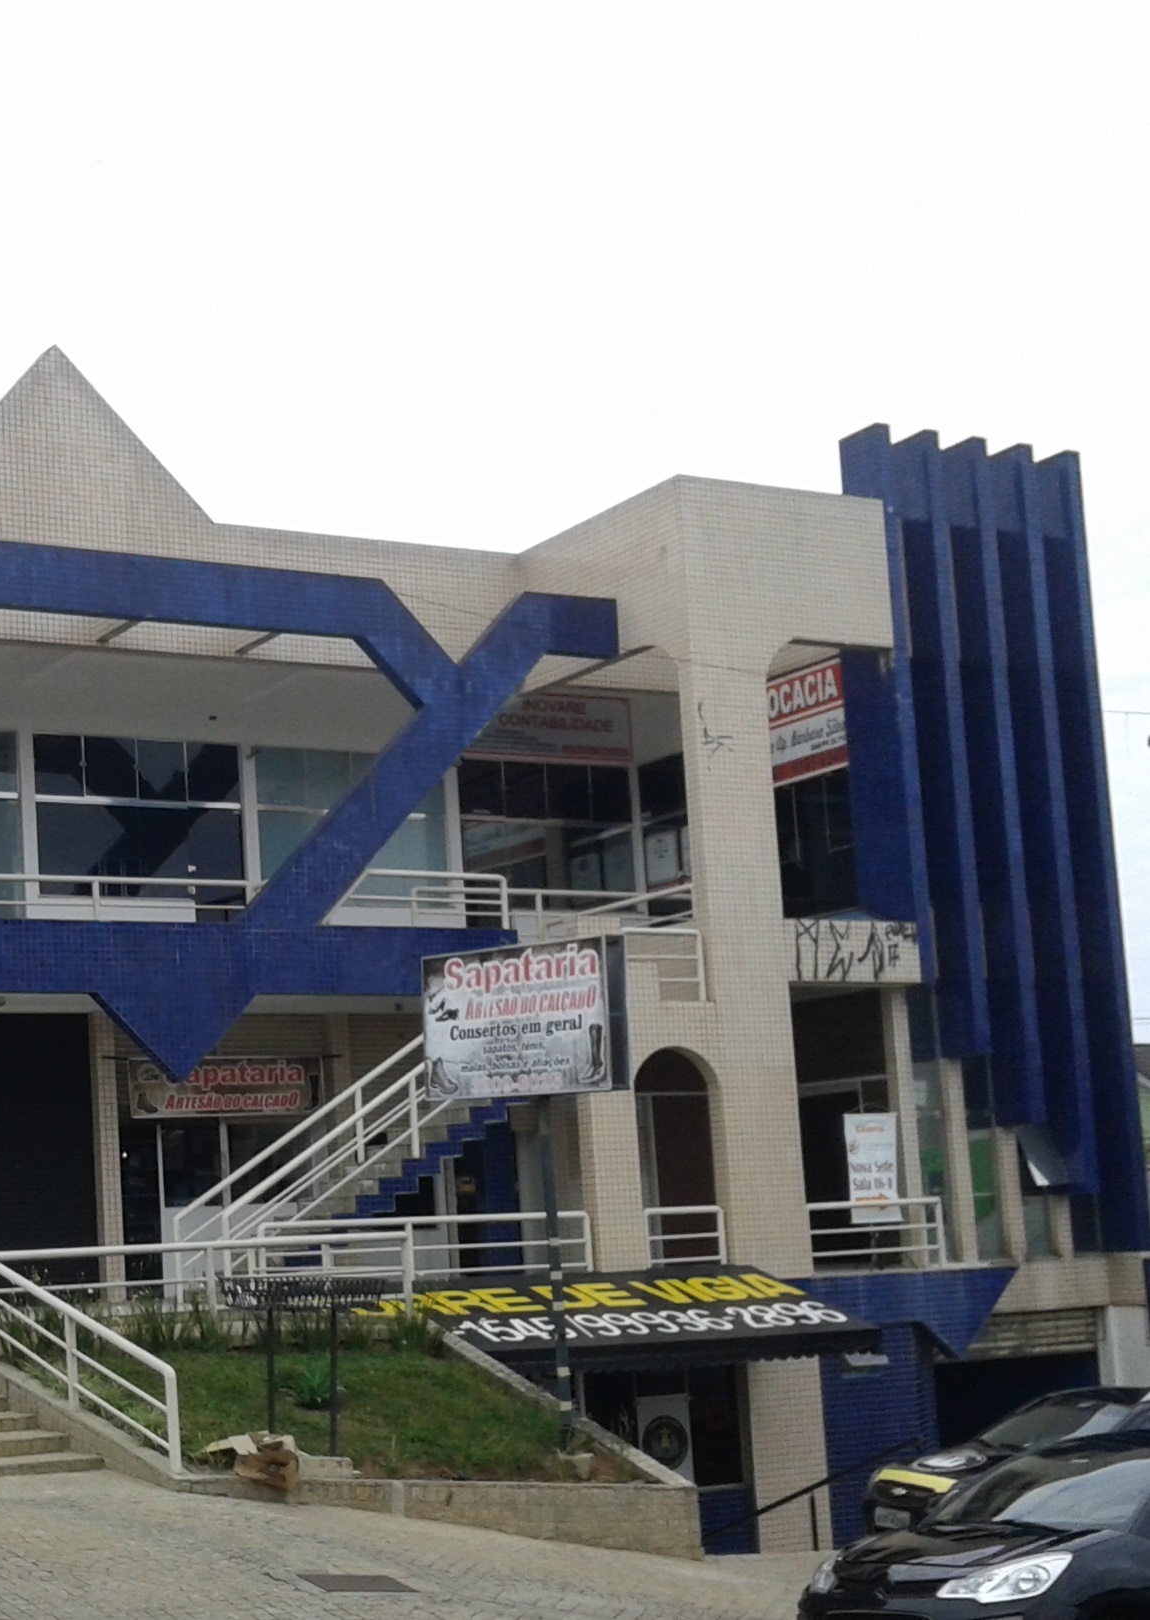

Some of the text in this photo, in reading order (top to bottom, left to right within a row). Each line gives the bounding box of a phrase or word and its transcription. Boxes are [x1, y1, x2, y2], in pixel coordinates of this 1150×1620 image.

[498, 712, 613, 733] CONTABILIDADE
[443, 943, 600, 995] Sapataria
[520, 993, 536, 1015] DO
[450, 1014, 583, 1041] Consertos em geral
[164, 1058, 305, 1092] apataria
[223, 1094, 241, 1110] DO
[242, 1091, 300, 1111] CALÇADO
[349, 1273, 806, 1317] ORRE DE VIGIA
